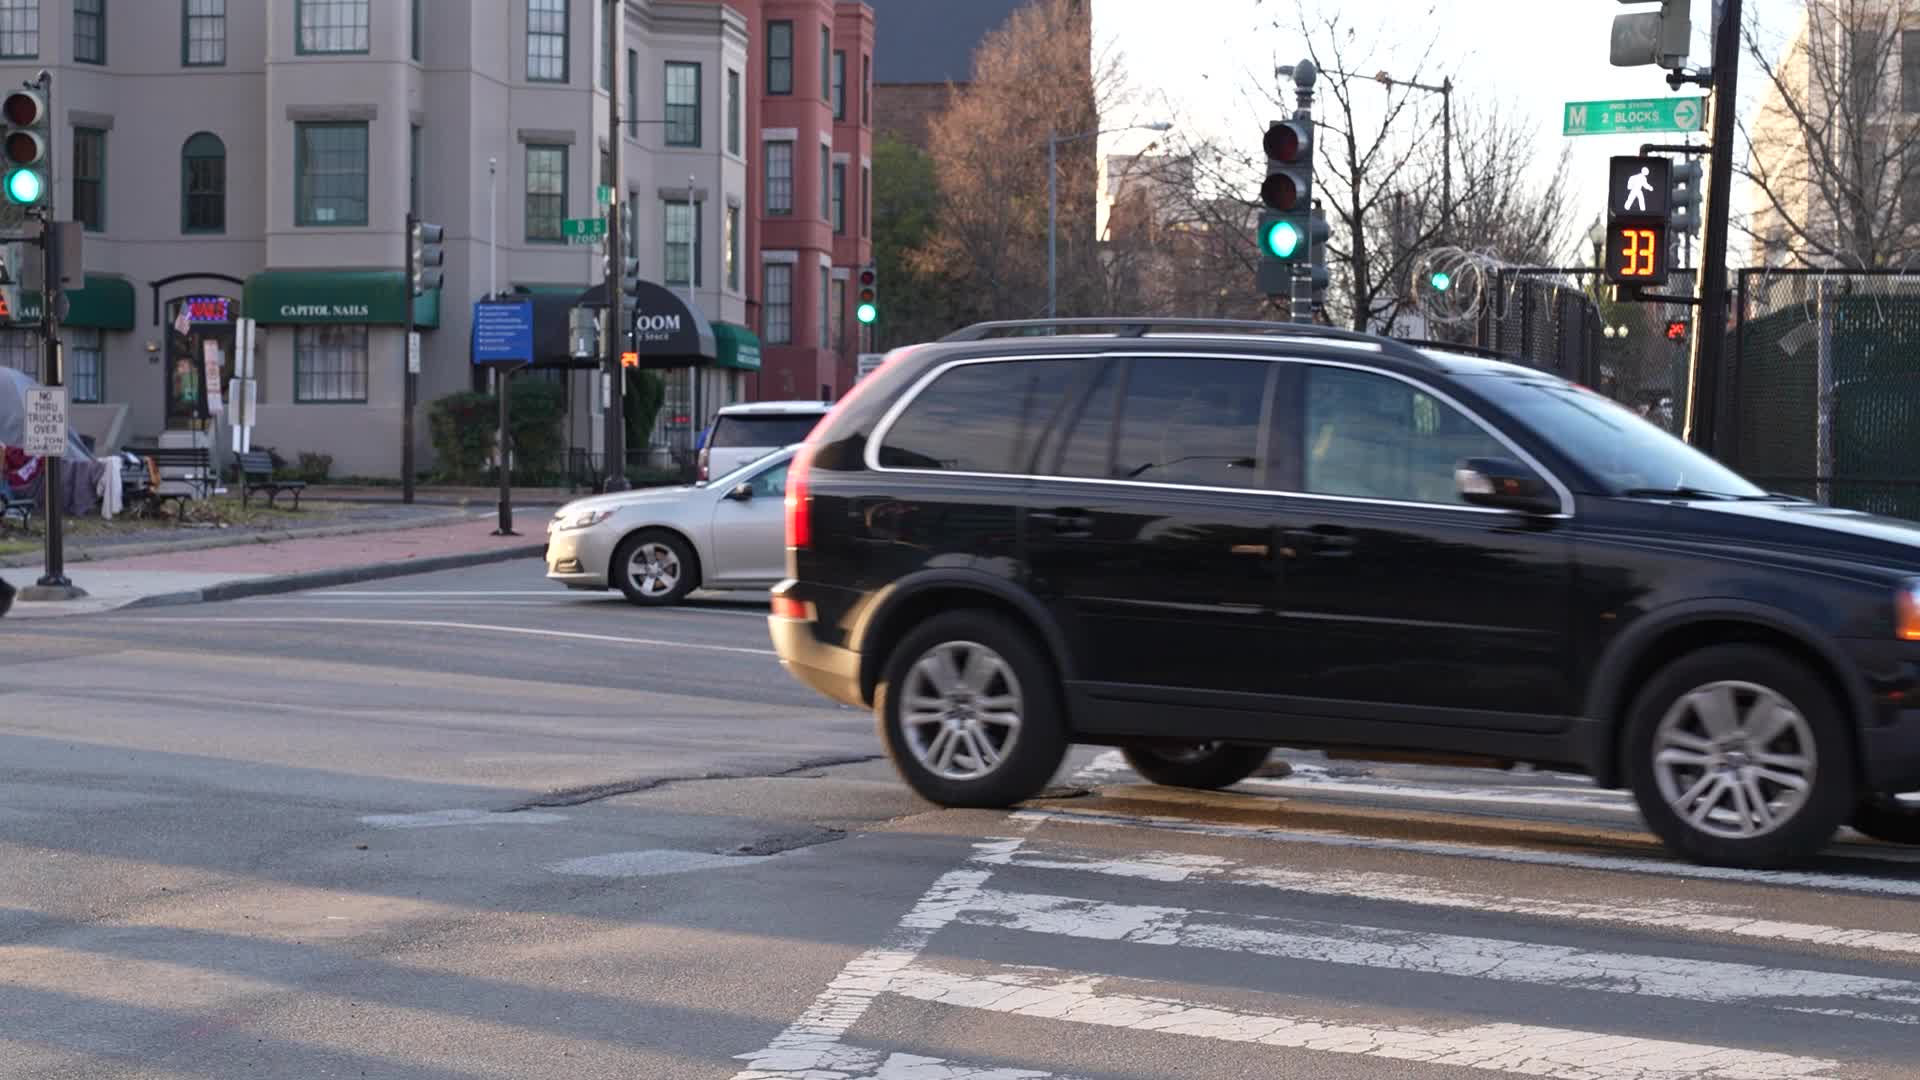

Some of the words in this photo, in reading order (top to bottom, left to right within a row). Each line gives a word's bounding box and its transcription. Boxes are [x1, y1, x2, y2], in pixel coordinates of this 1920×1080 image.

[1569, 105, 1586, 128] M
[1615, 111, 1660, 123] BLOCKS
[1621, 229, 1655, 275] 33
[280, 304, 331, 316] CAPITOL
[332, 304, 369, 316] NAILS
[636, 314, 681, 331] OOM
[40, 391, 52, 401] NO
[34, 402, 58, 412] THRU
[28, 413, 64, 424] TRUCKS
[34, 424, 58, 434] OVER
